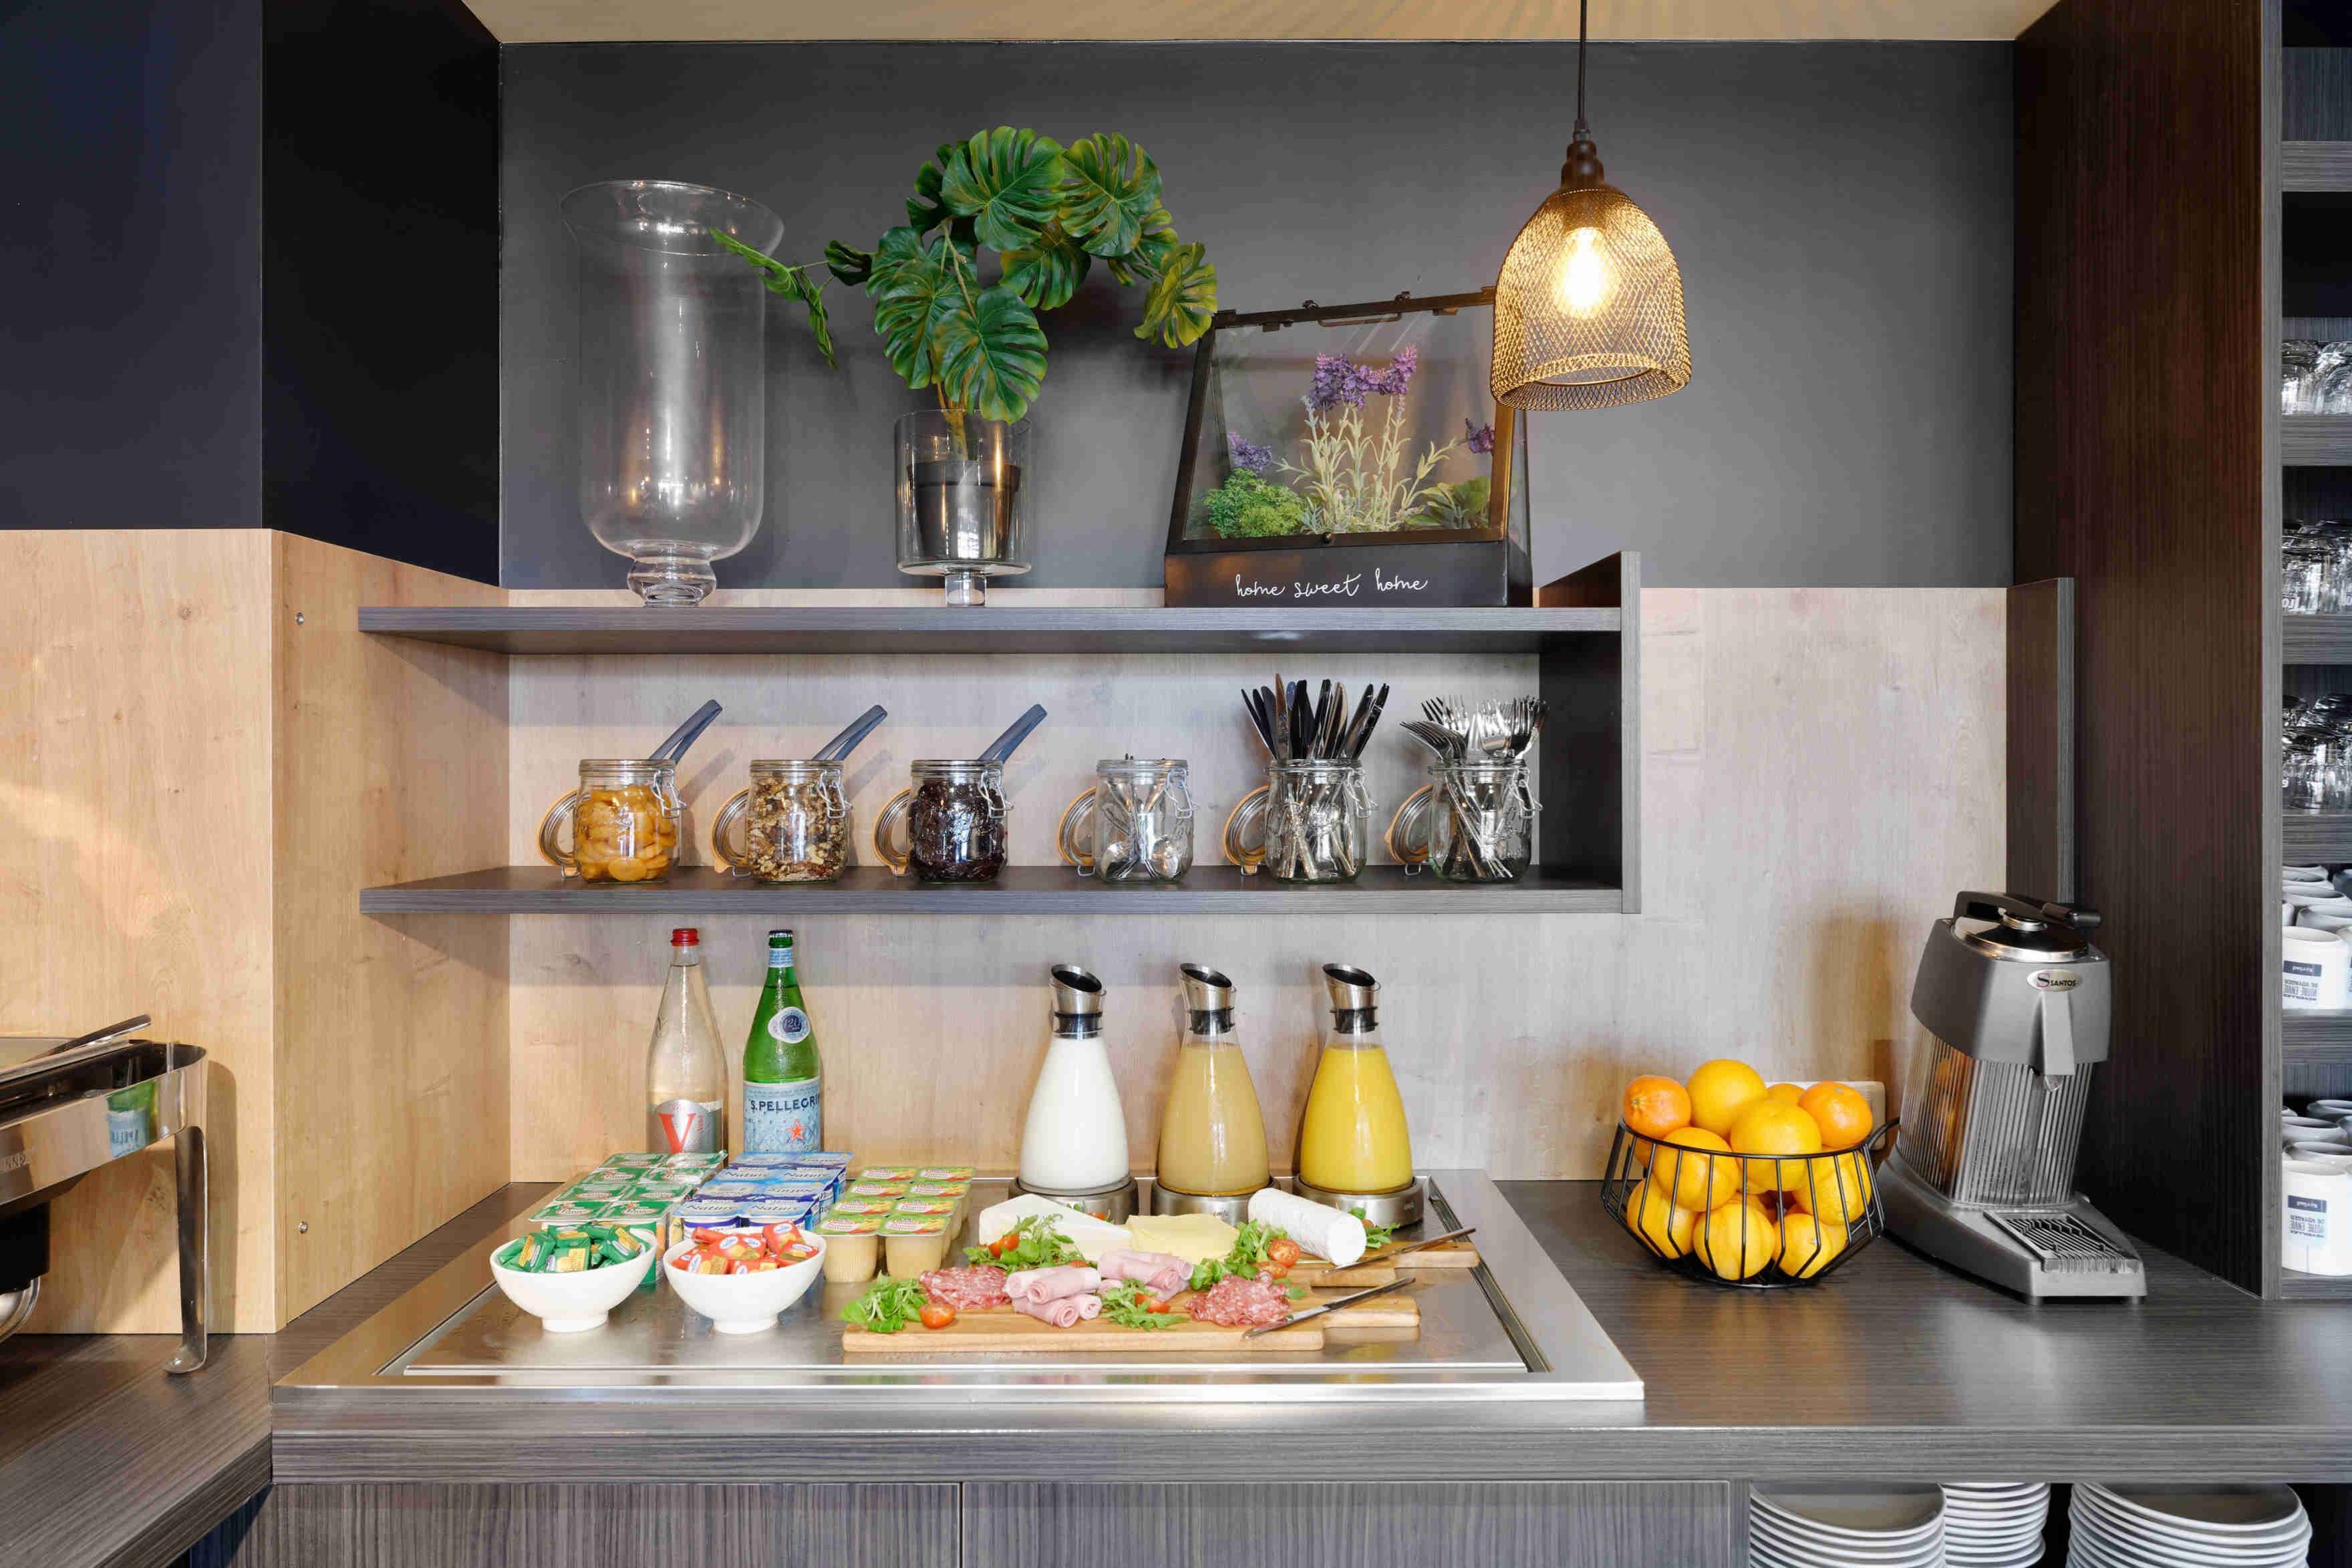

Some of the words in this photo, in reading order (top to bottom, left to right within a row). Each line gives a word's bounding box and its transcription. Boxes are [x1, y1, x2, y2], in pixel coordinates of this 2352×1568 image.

[1235, 573, 1286, 597] home
[1294, 573, 1362, 599] sweet
[1375, 568, 1429, 592] home
